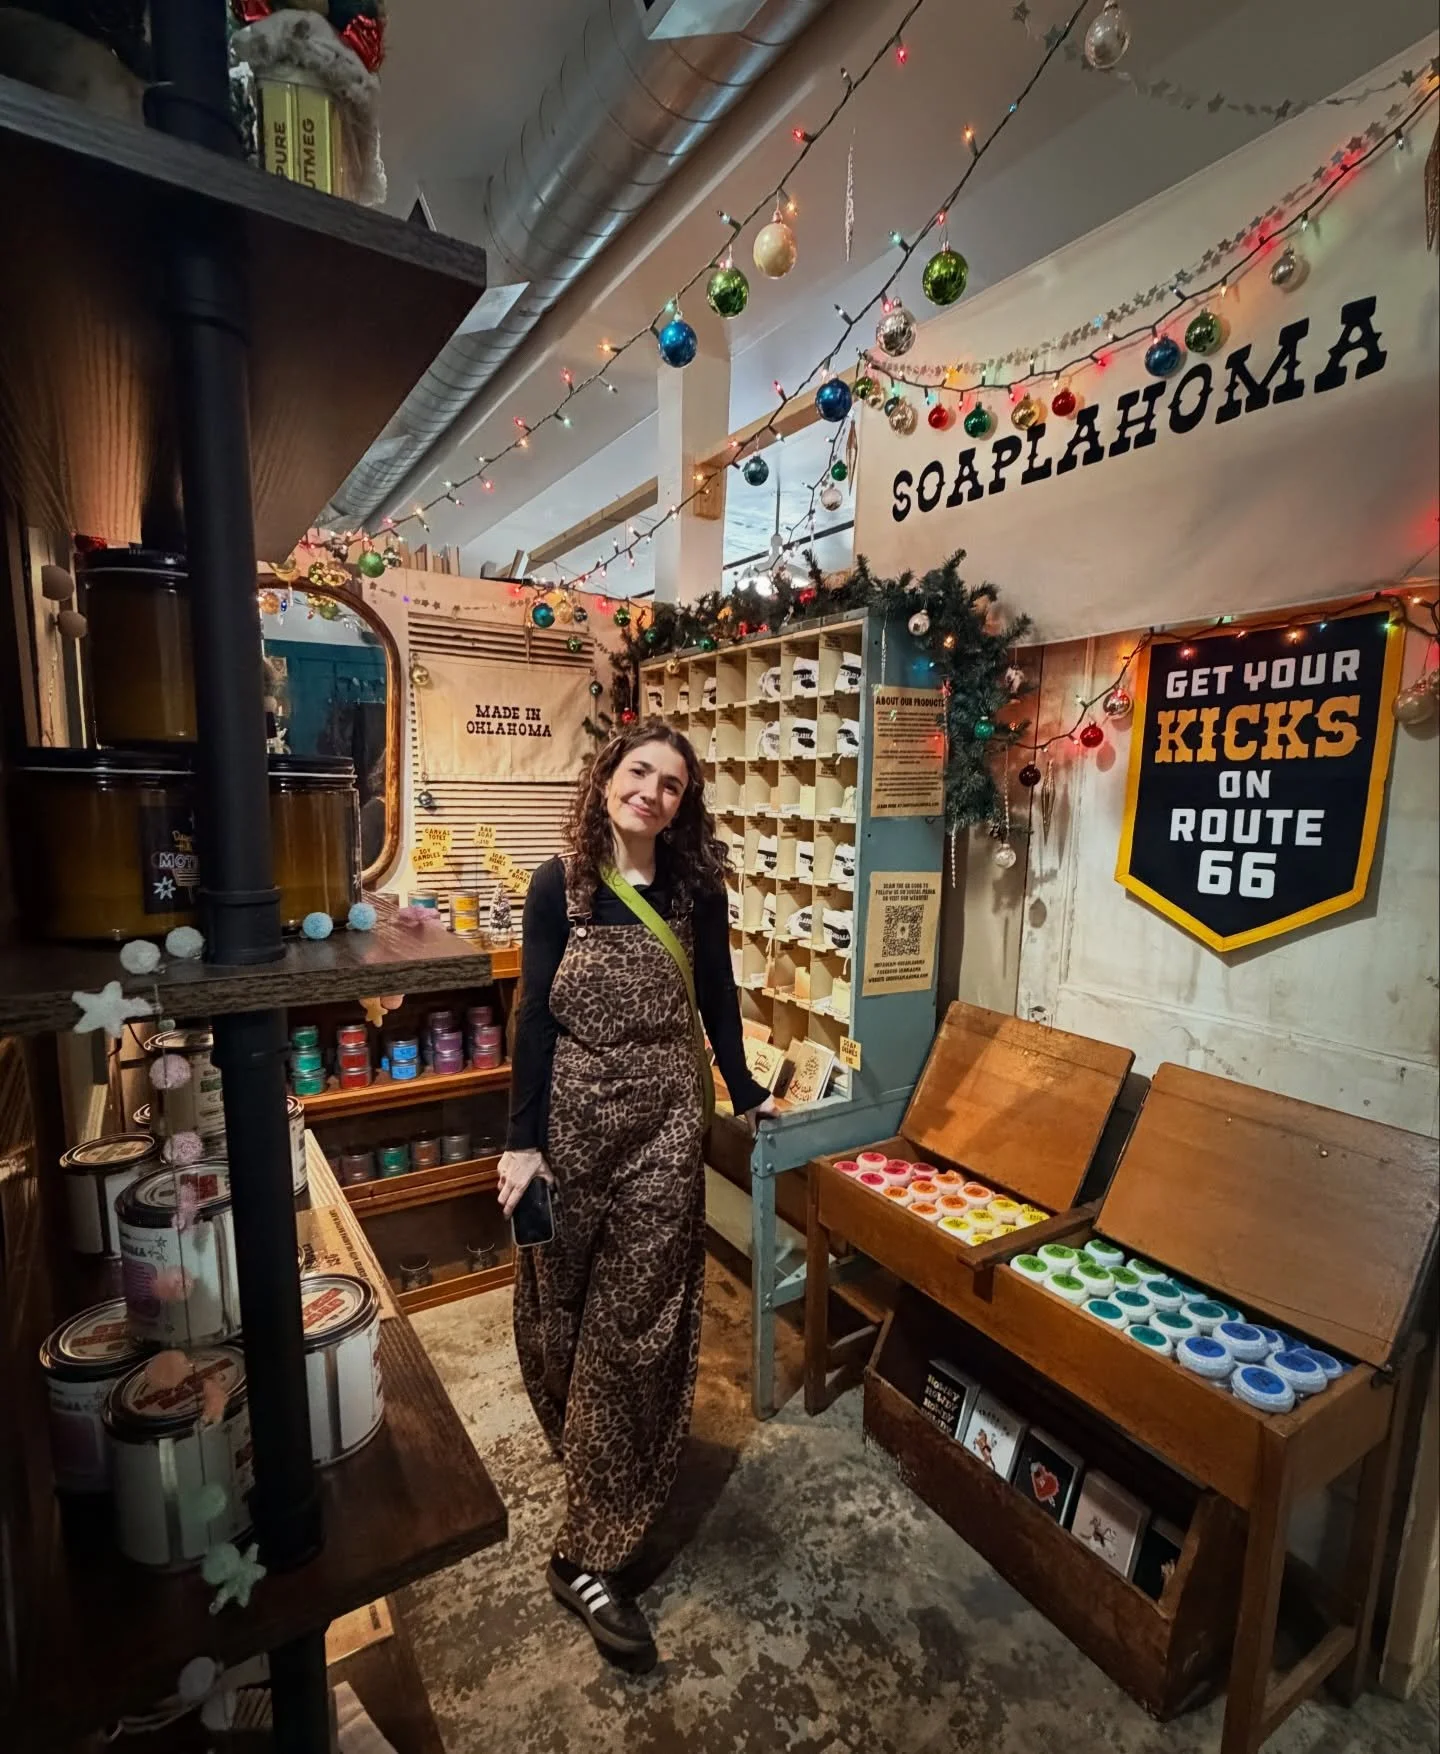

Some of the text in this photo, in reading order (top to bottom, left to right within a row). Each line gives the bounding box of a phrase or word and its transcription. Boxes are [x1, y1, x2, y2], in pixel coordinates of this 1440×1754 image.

[892, 296, 1388, 522] SOAPLAHOMA
[1166, 649, 1360, 699] GET YOUR
[475, 704, 541, 721] MADE IN
[875, 695, 899, 706] ABOUT
[900, 696, 913, 706] OUR
[466, 720, 552, 737] OKLAHOMA
[1154, 695, 1362, 764] KICKS
[1219, 770, 1272, 799] ON
[1169, 808, 1325, 846] ROUTE
[1197, 850, 1277, 899] 66
